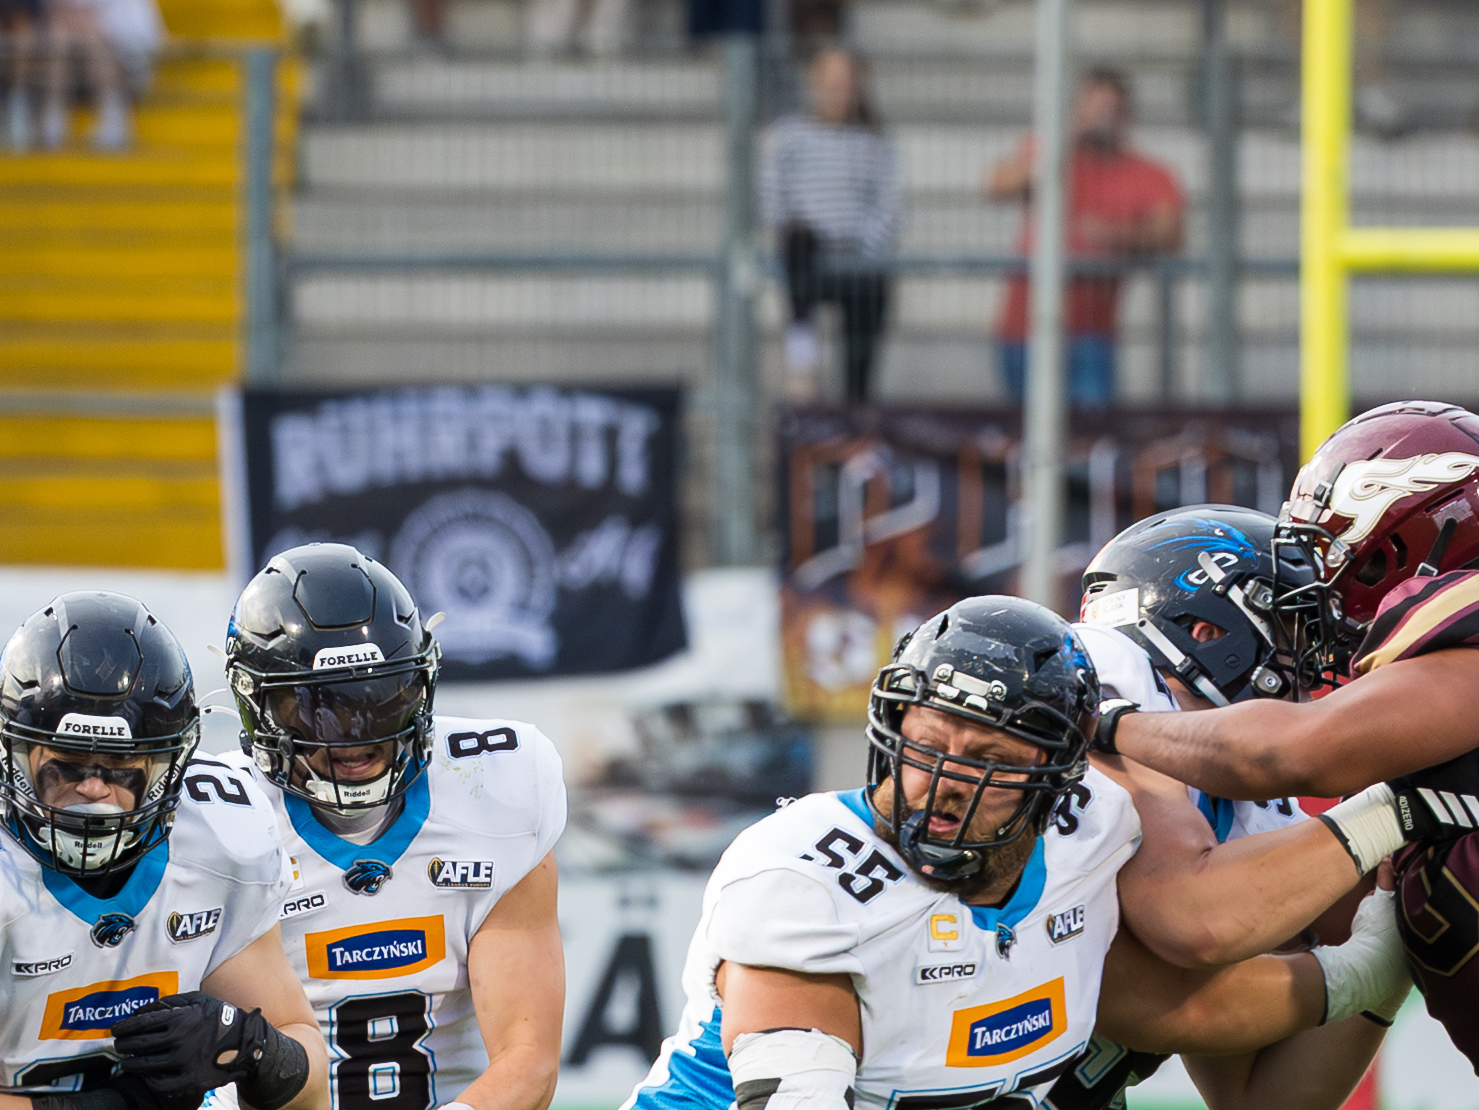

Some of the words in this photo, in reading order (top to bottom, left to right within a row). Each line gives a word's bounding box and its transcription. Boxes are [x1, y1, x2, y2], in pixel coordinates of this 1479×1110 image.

[319, 651, 378, 668] FORELLE
[64, 722, 125, 737] FORELLE
[444, 727, 521, 760] 8
[344, 789, 371, 798] Riddell
[436, 861, 492, 883] AFLE
[797, 824, 907, 906] 55
[175, 908, 222, 937] AFLE
[930, 914, 959, 940] C
[331, 939, 423, 967] TARCZYŃSKI
[973, 1009, 1050, 1050] TARCZYŃSKI
